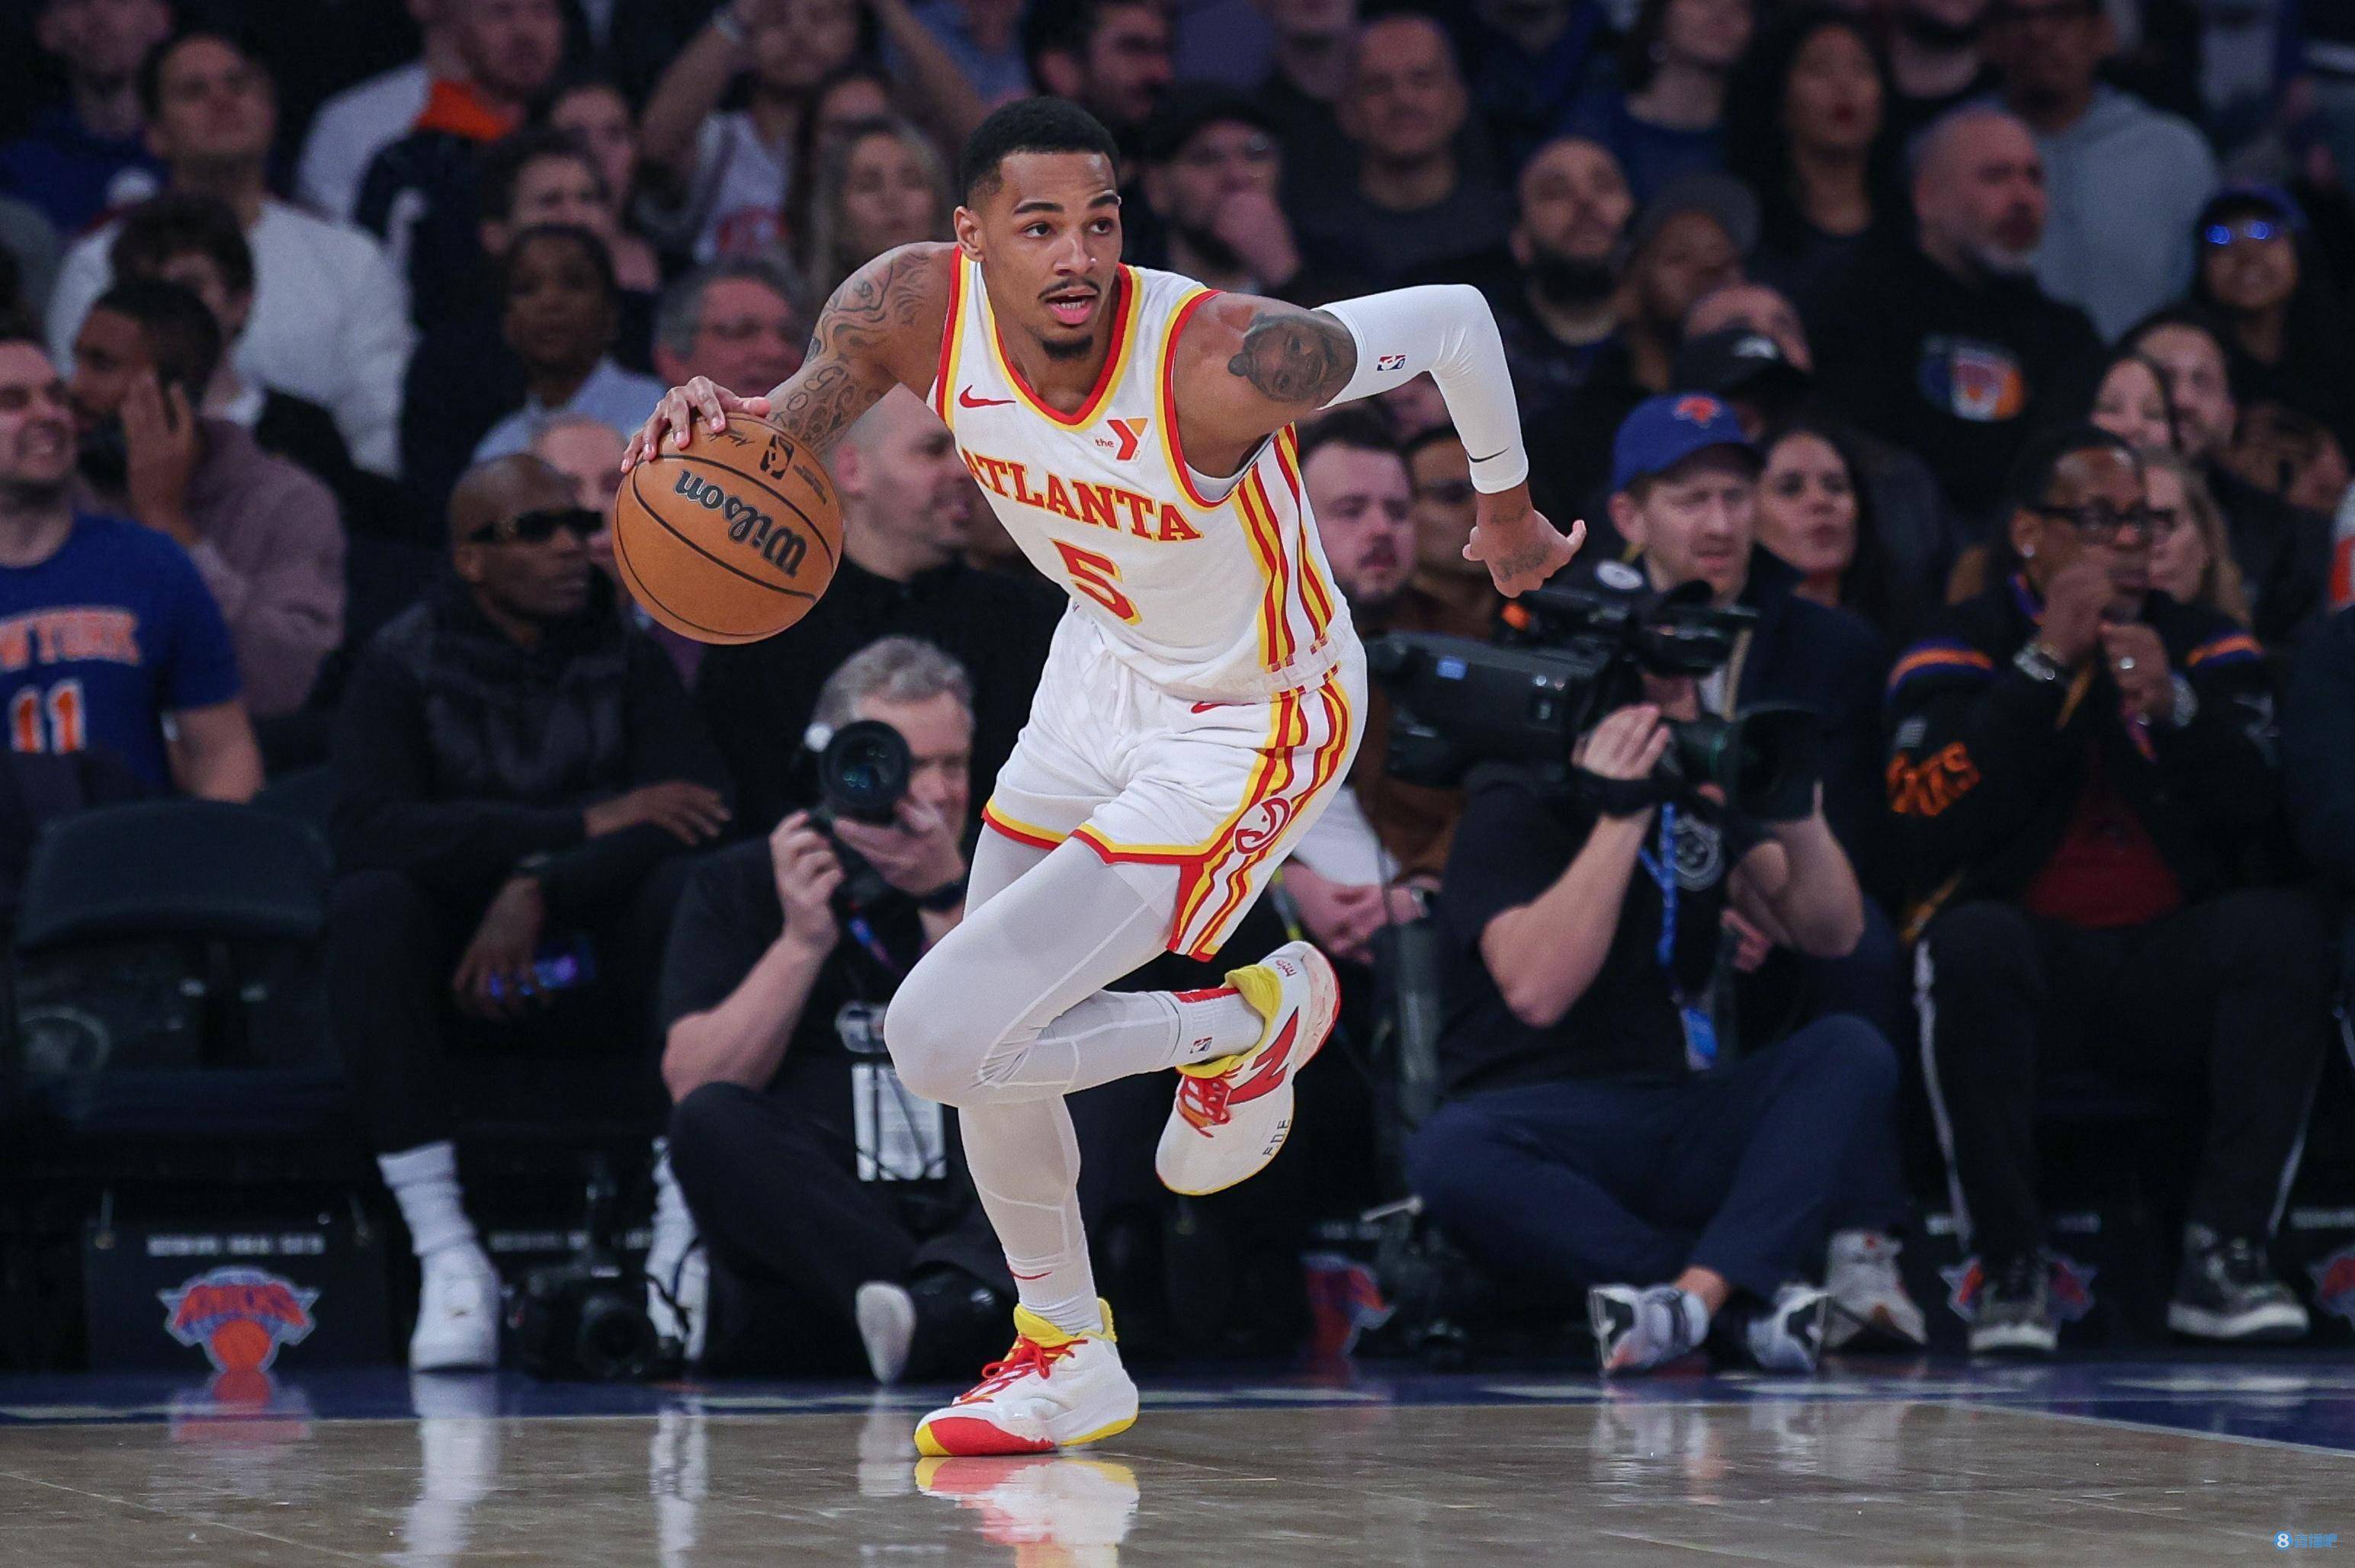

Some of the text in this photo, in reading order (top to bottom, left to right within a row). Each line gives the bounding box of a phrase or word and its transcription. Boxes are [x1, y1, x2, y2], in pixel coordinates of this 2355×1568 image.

[1095, 438, 1115, 448] the
[673, 469, 807, 578] Wilson
[961, 444, 1205, 543] ATLANTA
[1049, 537, 1143, 626] 5
[10, 679, 87, 755] 11
